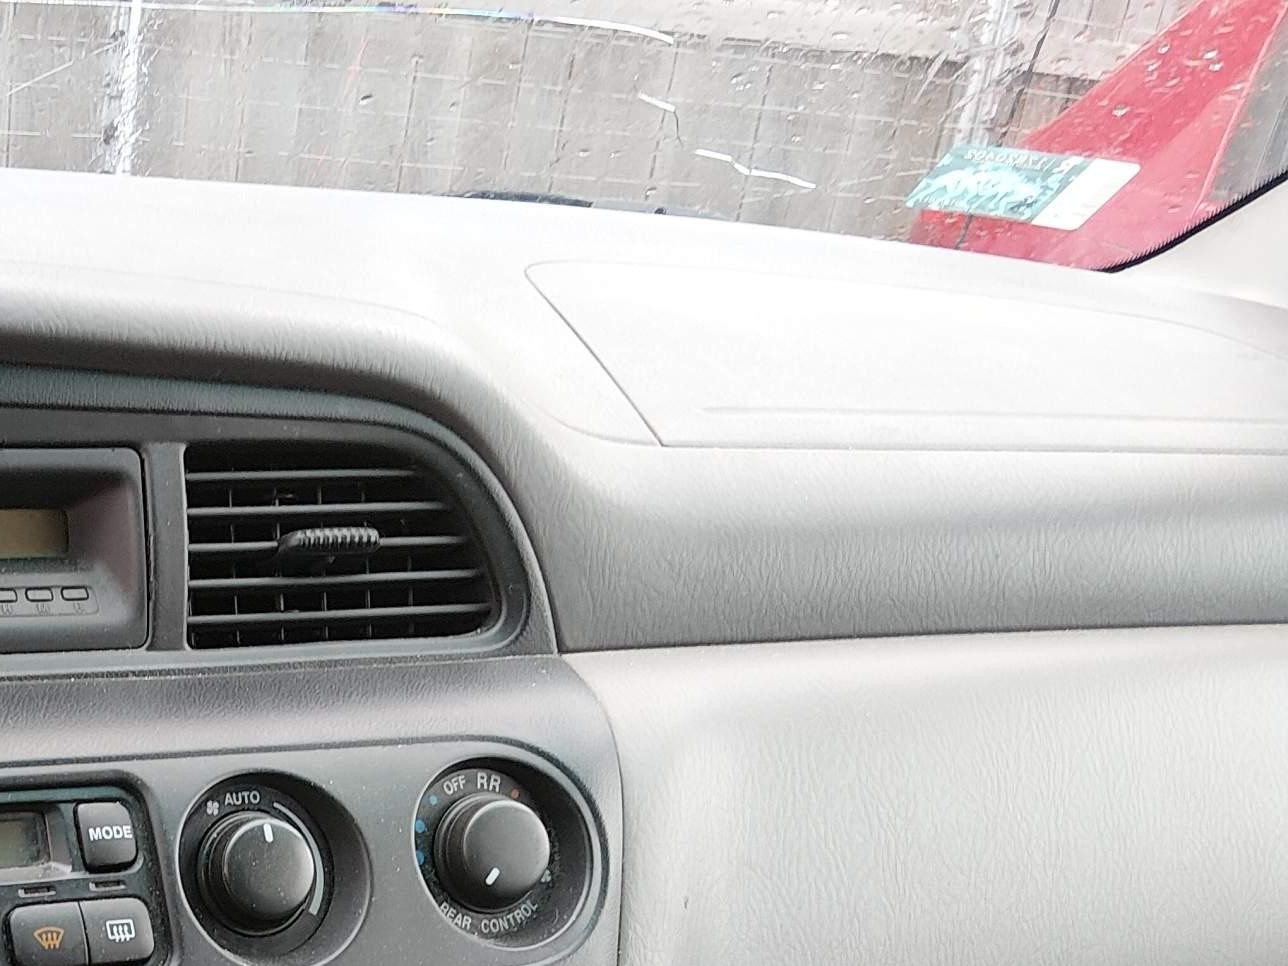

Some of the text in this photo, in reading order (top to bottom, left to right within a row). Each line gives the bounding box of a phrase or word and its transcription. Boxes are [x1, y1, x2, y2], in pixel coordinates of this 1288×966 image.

[443, 772, 501, 795] OFF RR
[224, 791, 260, 806] AUTO
[89, 826, 133, 841] MODE
[440, 900, 538, 933] REAR CONTROL
